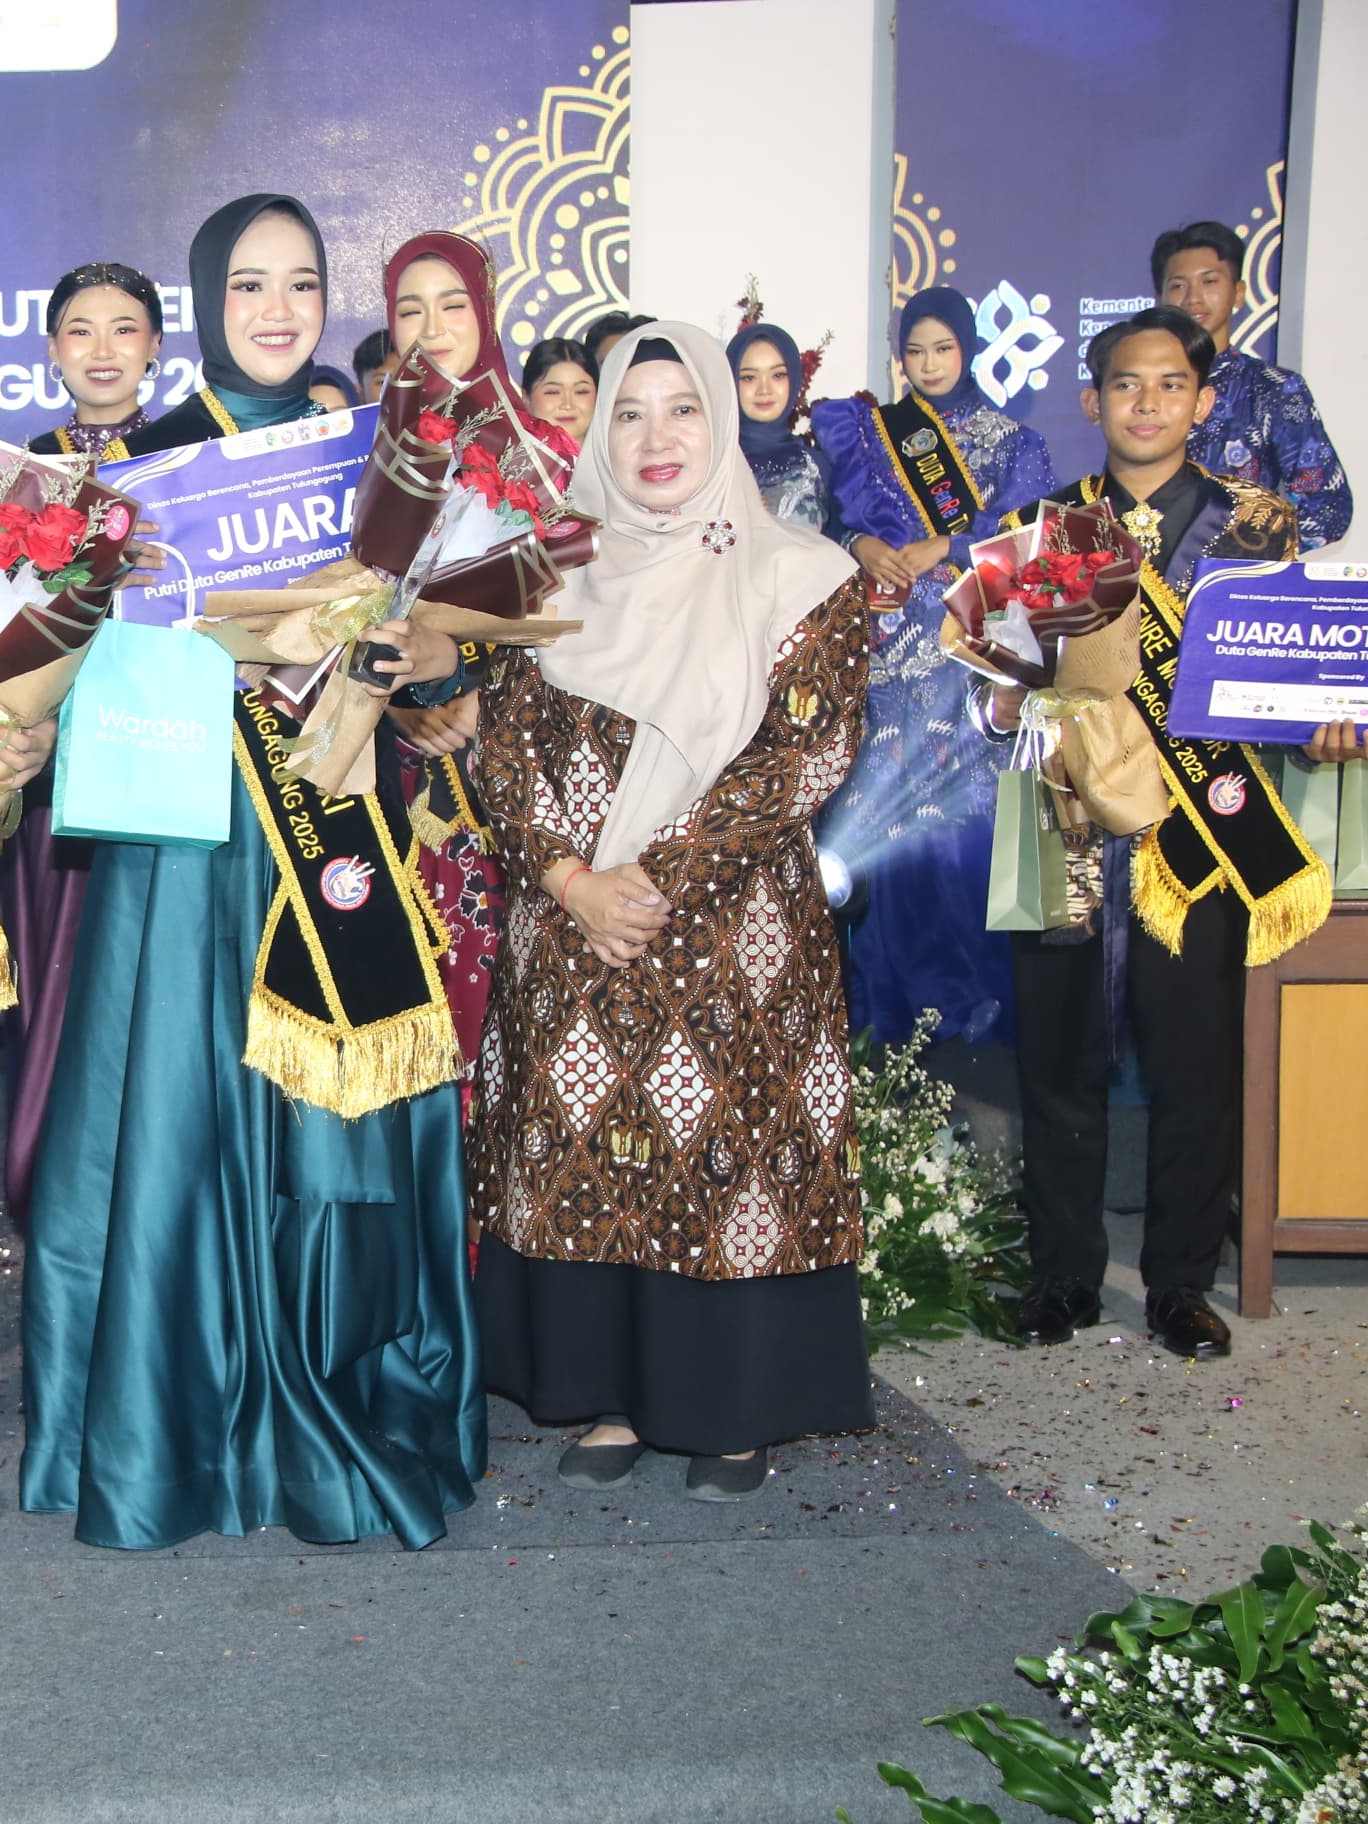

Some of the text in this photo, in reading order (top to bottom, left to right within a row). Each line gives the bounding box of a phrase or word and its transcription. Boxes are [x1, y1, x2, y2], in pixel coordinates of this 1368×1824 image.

[1079, 297, 1155, 314] Kemente
[248, 473, 344, 499] Kabupaten Tulungagung
[252, 468, 312, 487] Pemberdayaan
[312, 458, 357, 474] Perempuan
[915, 452, 947, 486] DUTA
[930, 480, 962, 519] GenRe
[144, 580, 177, 600] Putri
[179, 575, 214, 592] Duta
[214, 564, 262, 584] GenRe
[263, 547, 342, 574] Kabupaten
[1206, 620, 1304, 646] JUARA
[1215, 644, 1245, 656] Duta
[1246, 646, 1287, 658] GenRe
[1288, 647, 1358, 662] Kabupaten
[97, 703, 207, 741] Wardah
[1176, 746, 1208, 784] 2025
[289, 810, 325, 860] 2025
